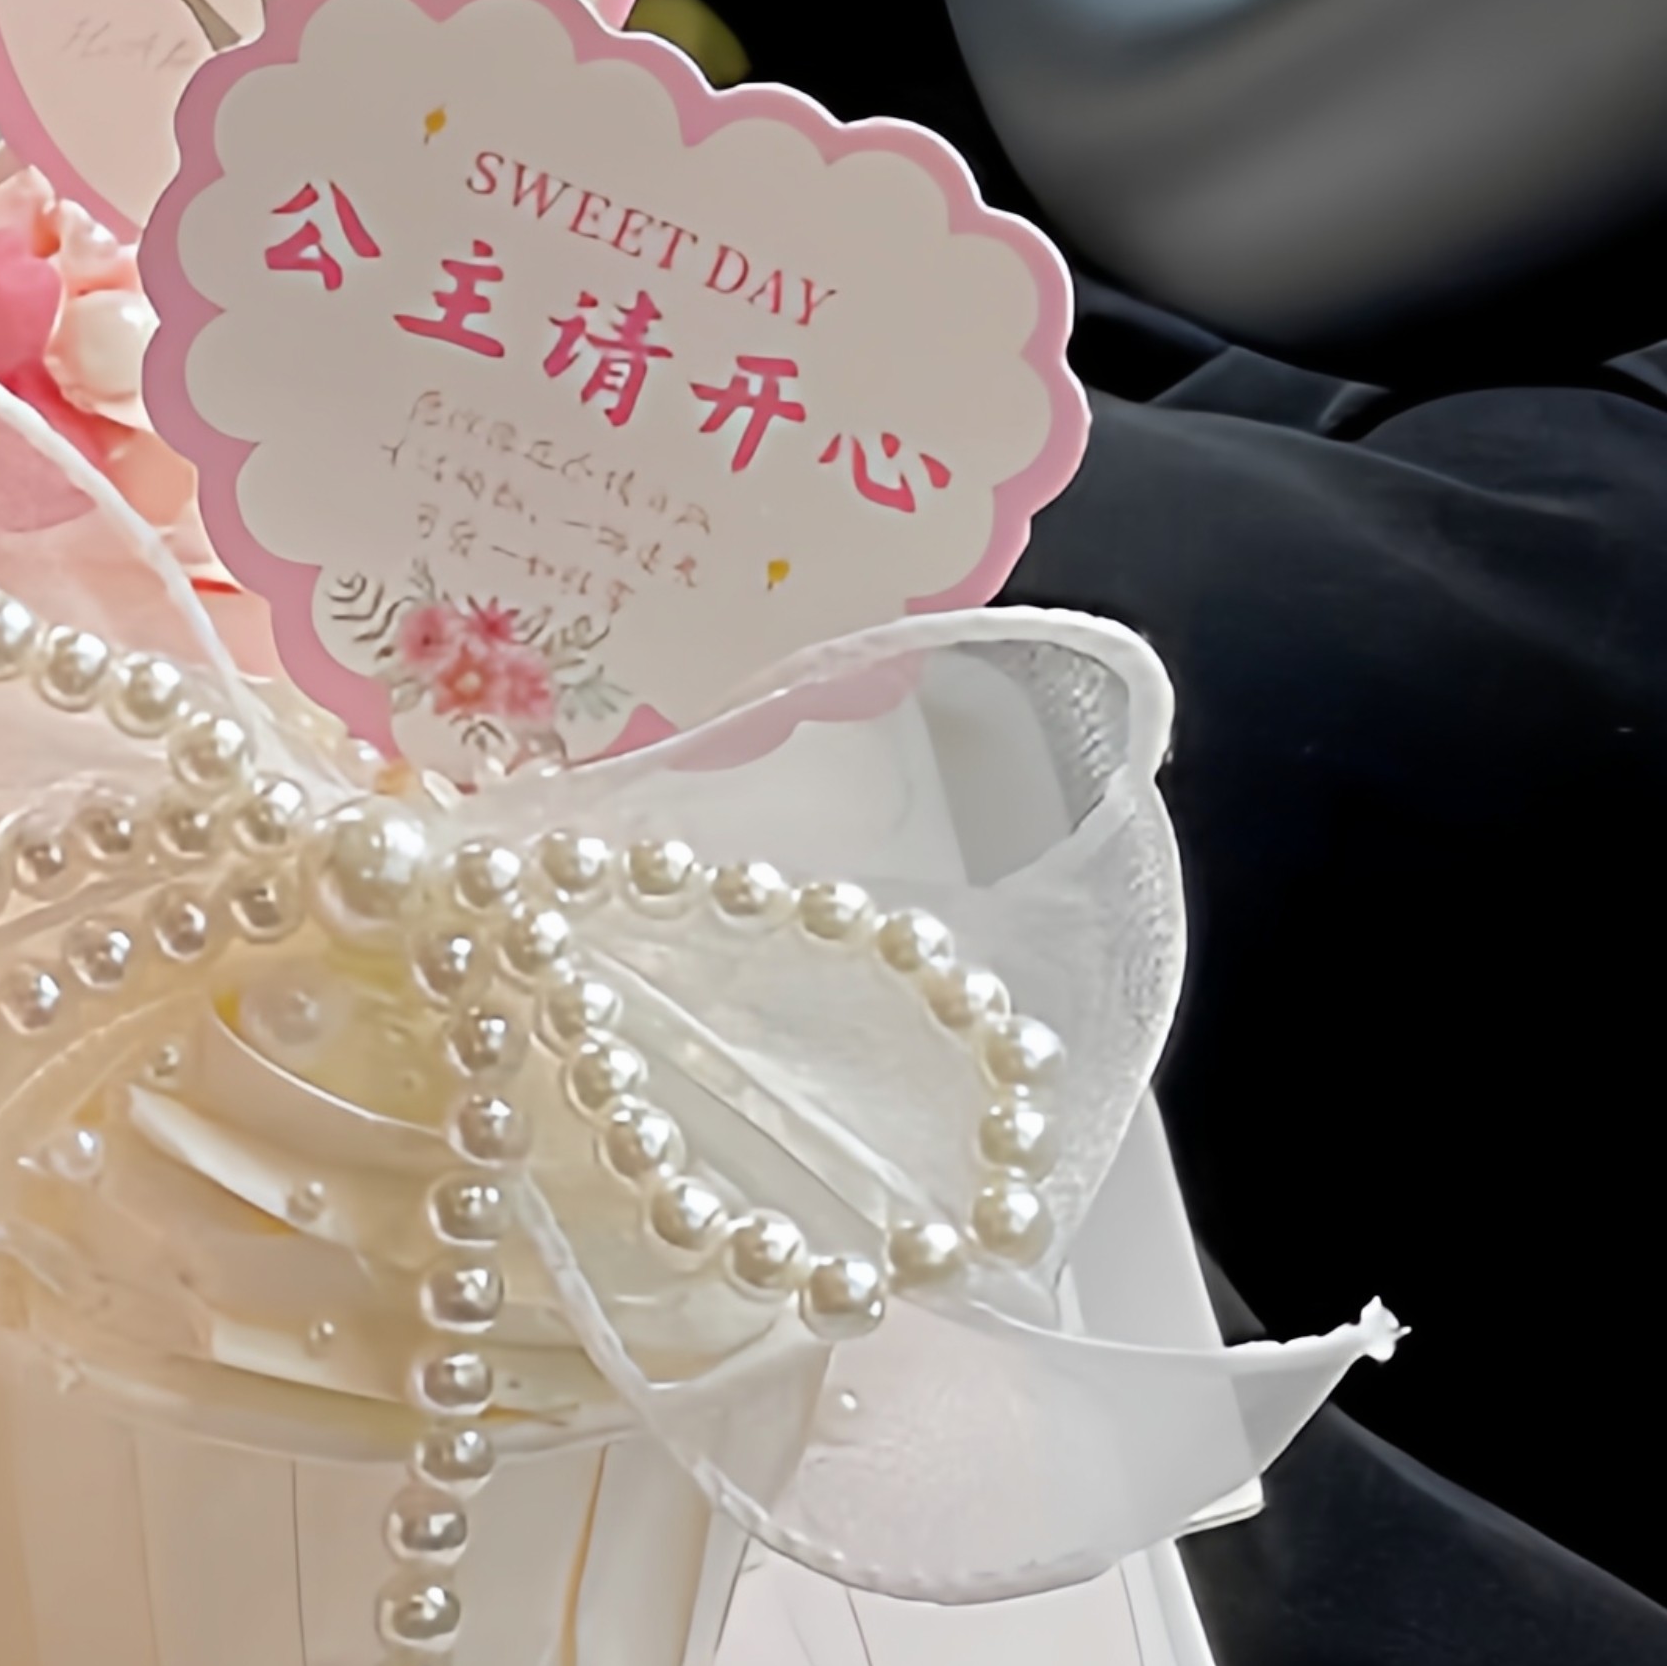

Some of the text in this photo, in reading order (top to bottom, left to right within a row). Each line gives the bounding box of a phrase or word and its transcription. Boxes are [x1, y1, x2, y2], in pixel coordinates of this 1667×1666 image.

[264, 180, 951, 513] 公主请开心
[466, 150, 837, 327] SWEET DAY
